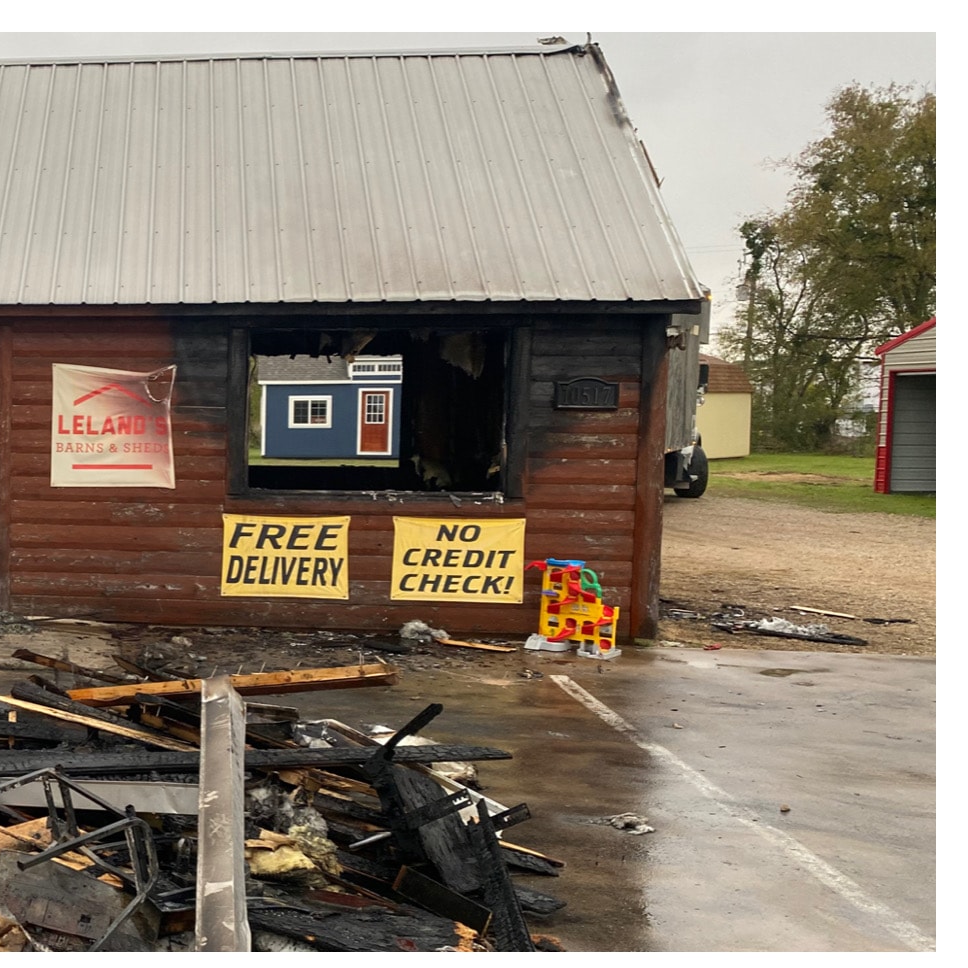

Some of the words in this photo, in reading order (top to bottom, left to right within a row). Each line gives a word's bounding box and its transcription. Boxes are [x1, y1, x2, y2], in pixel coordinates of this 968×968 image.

[58, 415, 167, 435] LELAND'S
[56, 443, 104, 453] BARNS
[109, 444, 117, 452] &
[228, 523, 344, 550] FREE
[436, 525, 481, 541] NO
[403, 548, 516, 568] CREDIT
[226, 555, 344, 586] DELIVERY
[399, 574, 514, 594] CHECK!
